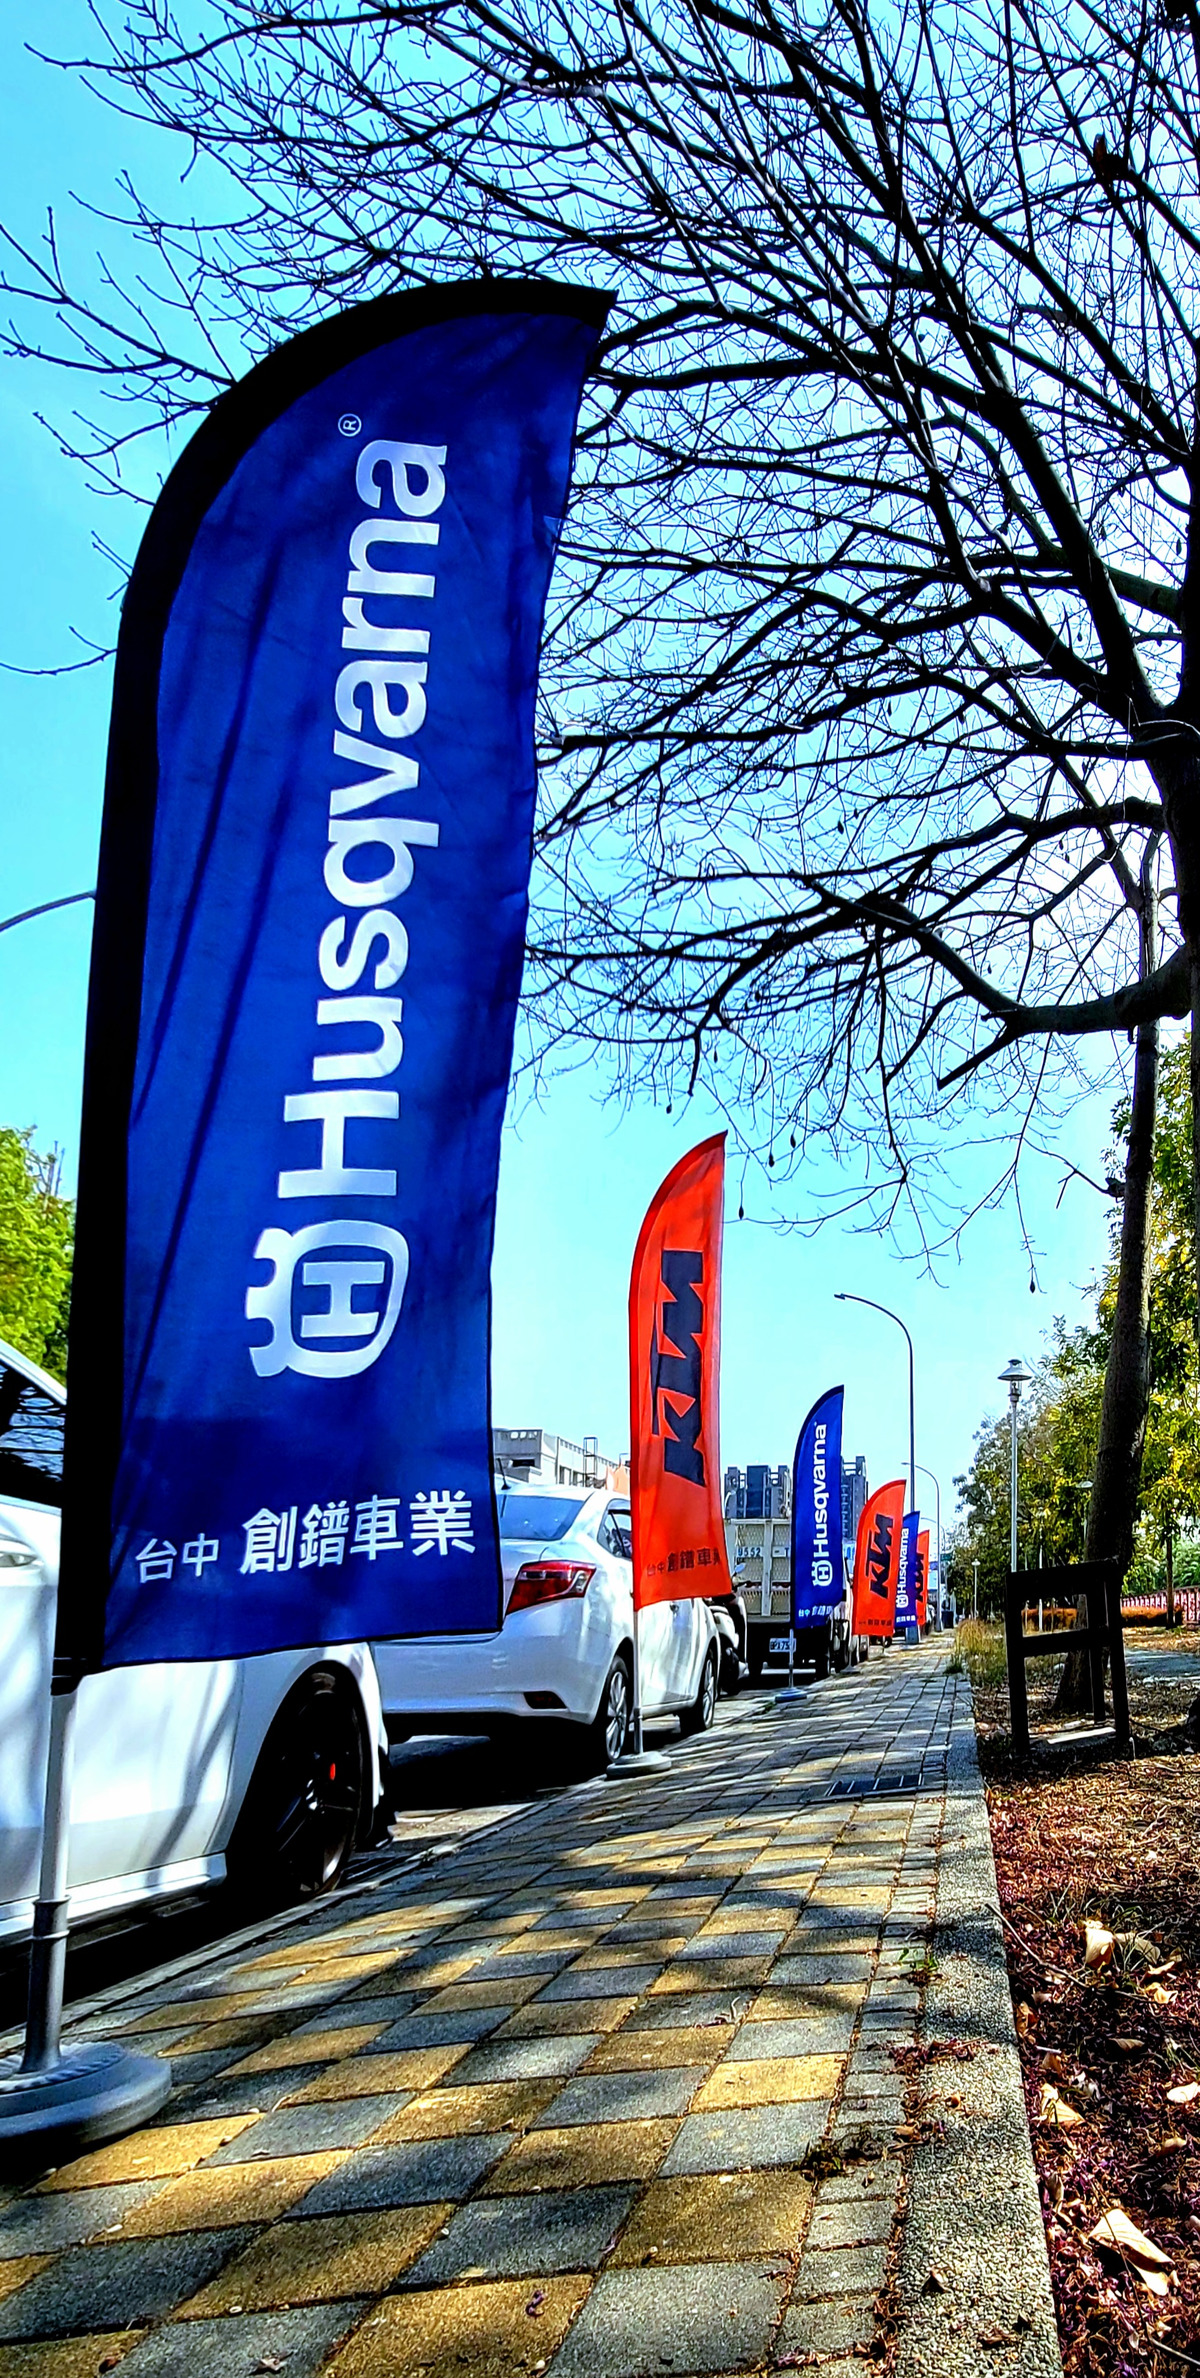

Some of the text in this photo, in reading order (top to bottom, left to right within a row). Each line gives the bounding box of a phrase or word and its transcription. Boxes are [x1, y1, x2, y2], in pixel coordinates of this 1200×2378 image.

[278, 440, 447, 1198] Husqvarna
[650, 1251, 705, 1487] KTM
[813, 1424, 829, 1557] Husqvarna
[135, 1533, 219, 1583] 台中
[866, 1513, 893, 1599] KTM
[897, 1528, 909, 1593] Husqvarna
